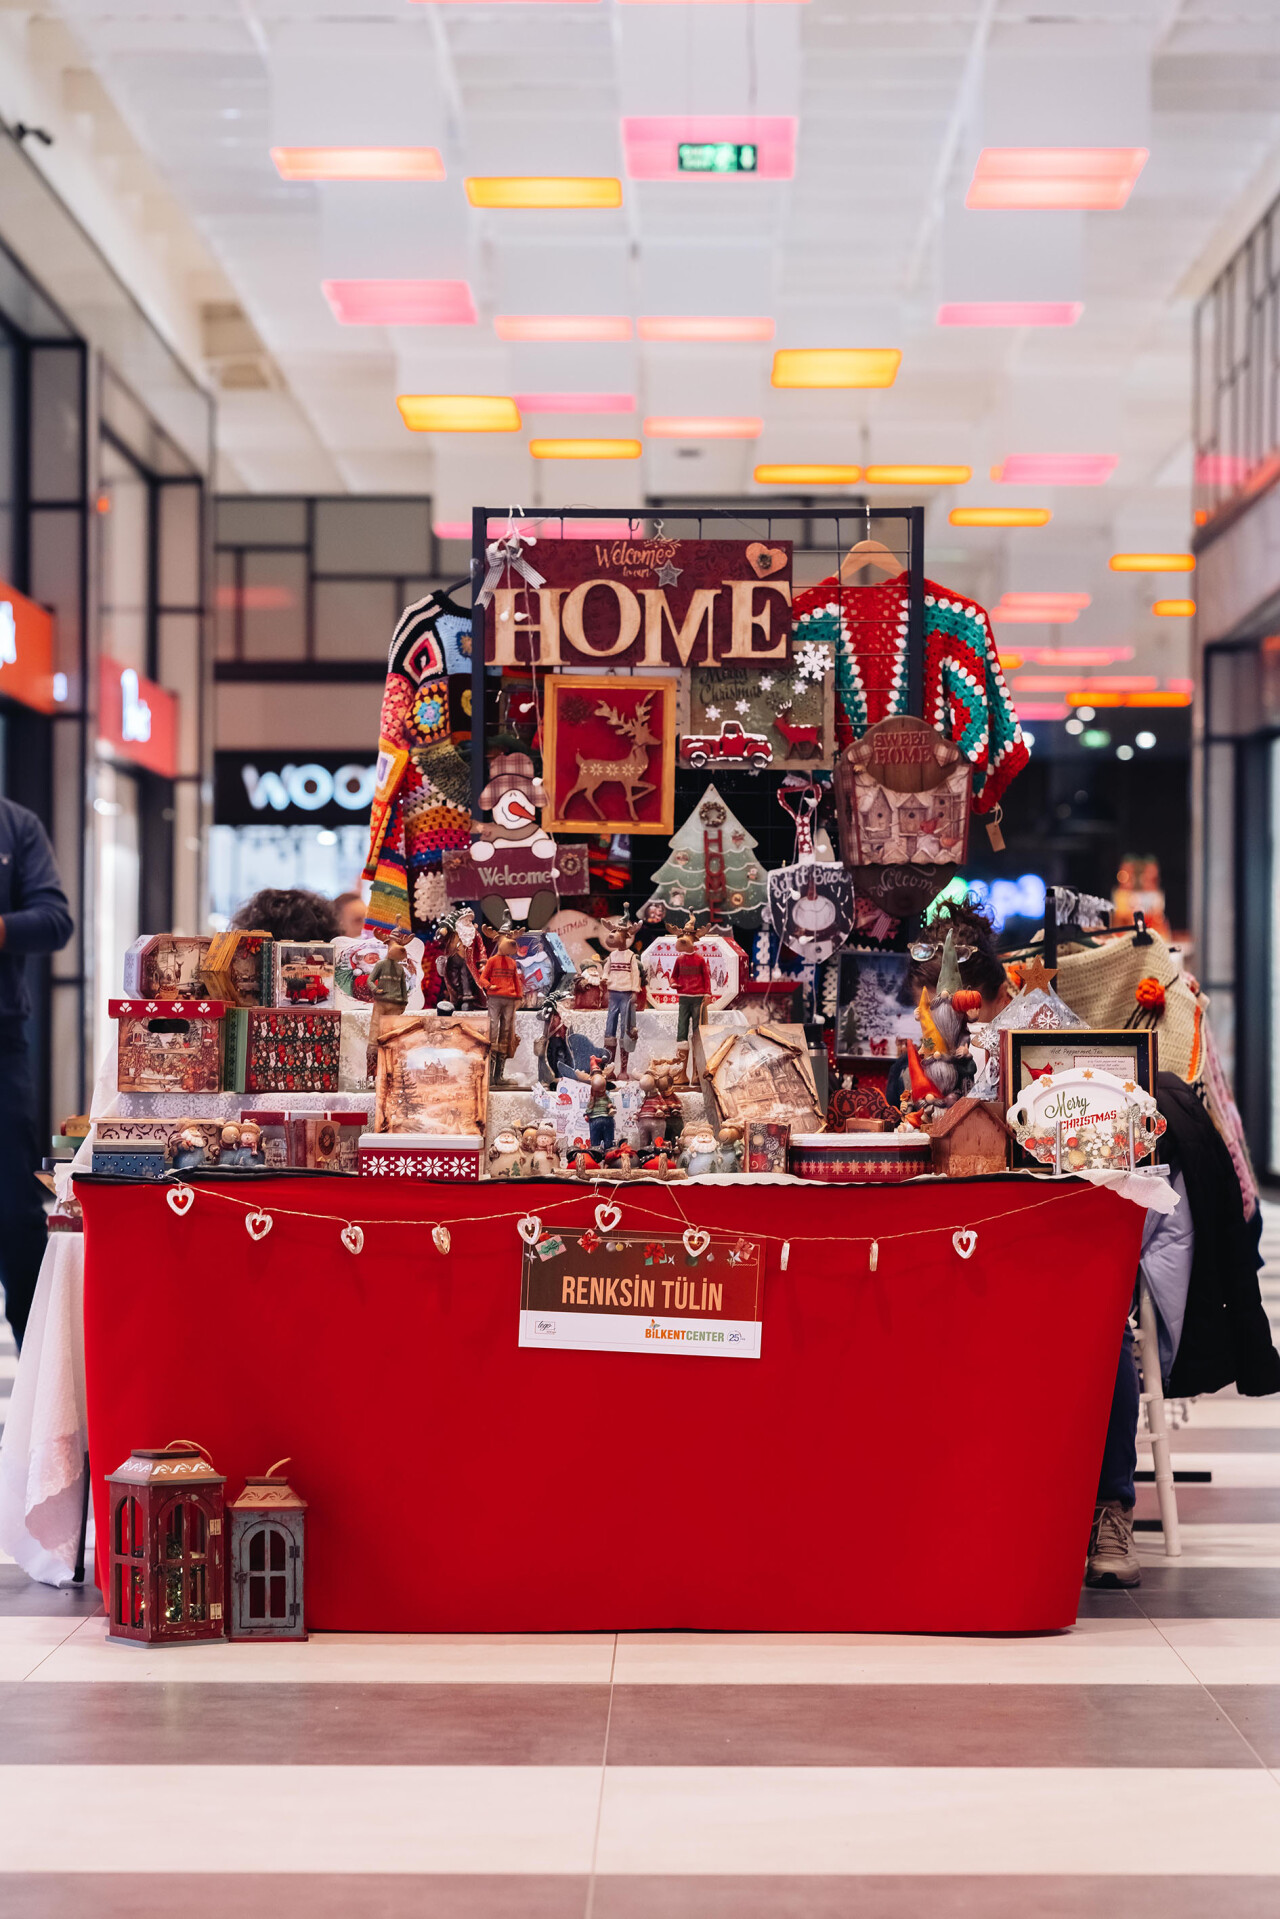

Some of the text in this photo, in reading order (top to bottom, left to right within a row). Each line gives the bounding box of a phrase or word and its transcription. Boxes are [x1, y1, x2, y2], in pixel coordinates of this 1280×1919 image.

[595, 541, 677, 569] Welcome
[485, 579, 792, 667] HOME
[874, 732, 931, 746] SWEET
[874, 746, 932, 764] HOME
[478, 865, 552, 887] Welcome
[795, 865, 810, 887] it
[1044, 1091, 1090, 1119] Merry
[1060, 1110, 1117, 1131] CHRISTMAS
[561, 1274, 723, 1311] RENKSİN TÜLİN
